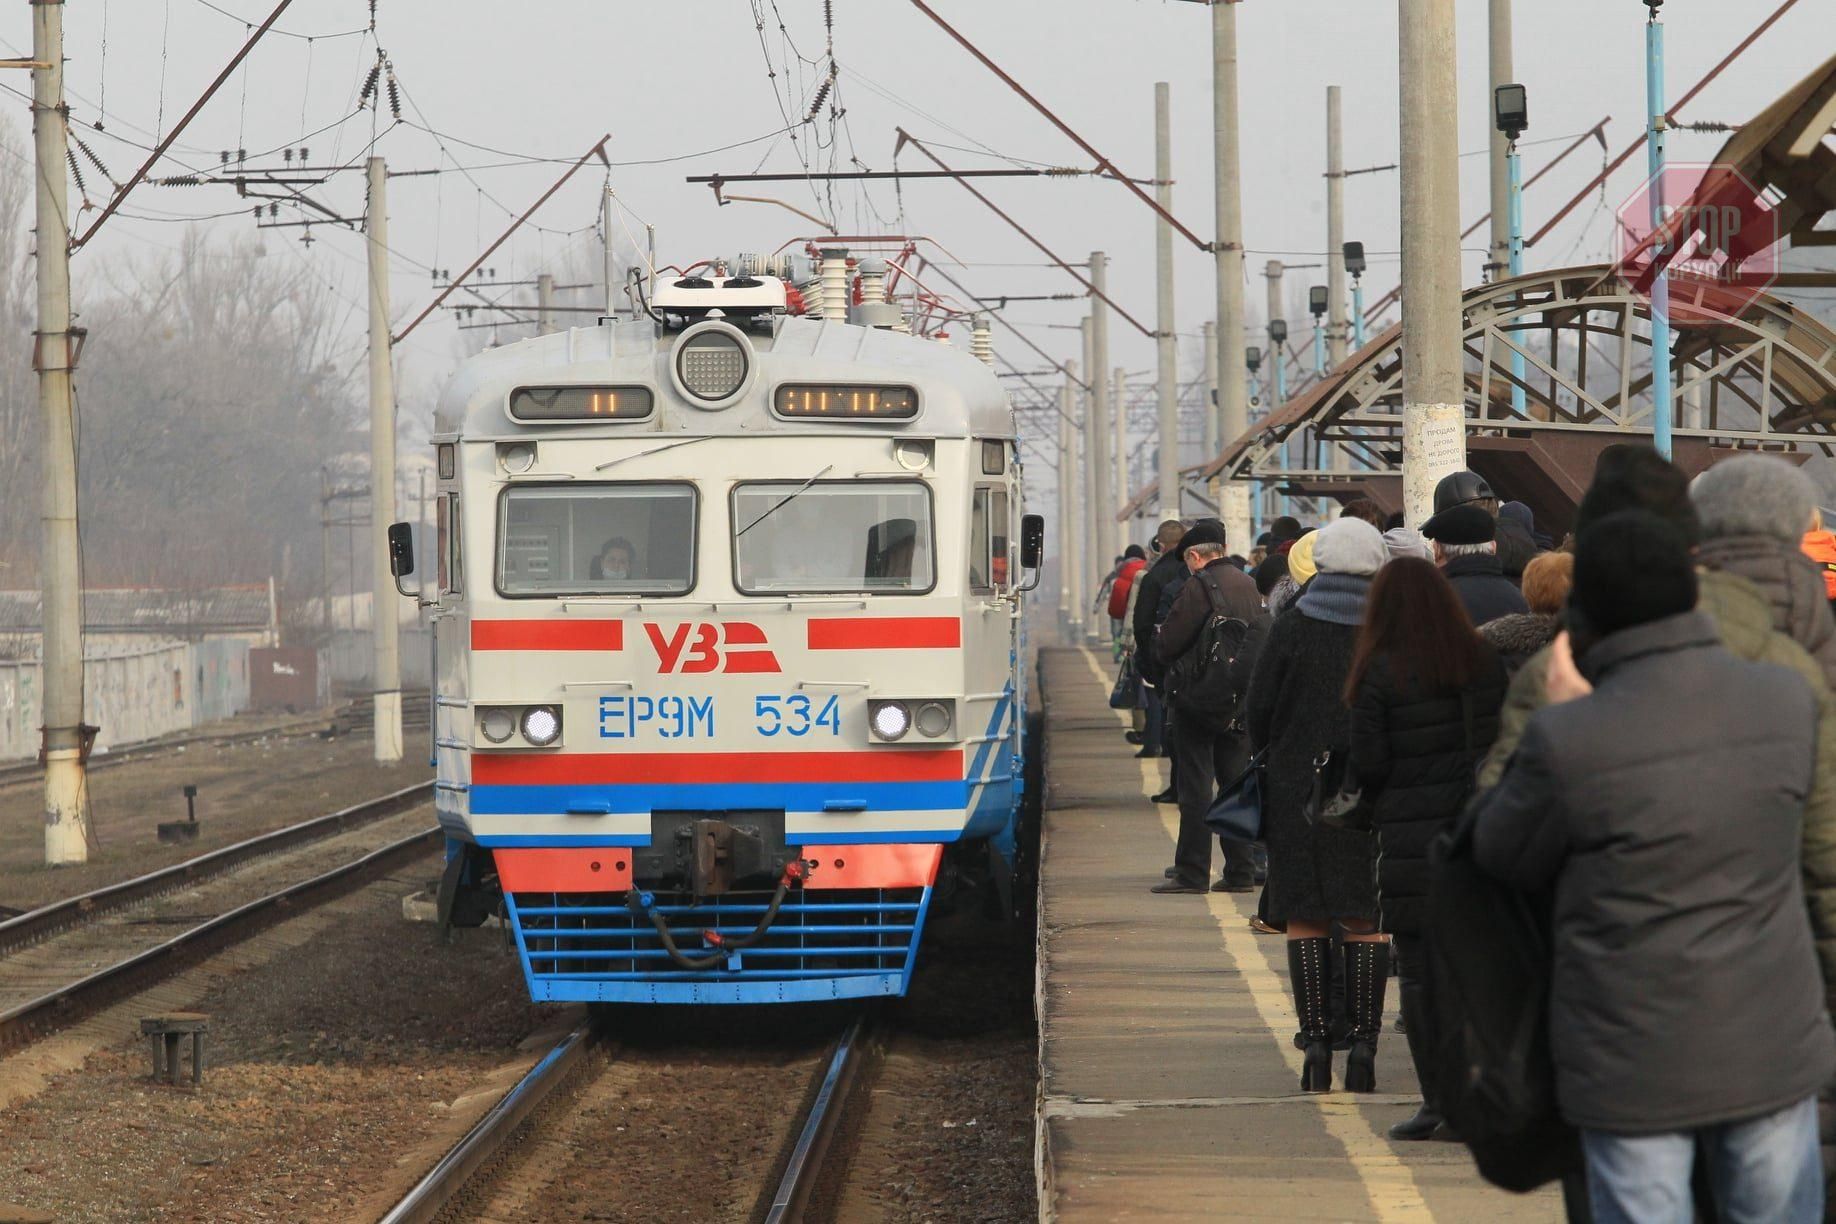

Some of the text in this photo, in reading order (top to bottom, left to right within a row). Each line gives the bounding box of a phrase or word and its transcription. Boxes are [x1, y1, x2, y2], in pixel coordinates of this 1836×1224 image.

[1427, 426, 1456, 437] ПРОДАМ
[599, 694, 841, 738] ЕР9М 534
